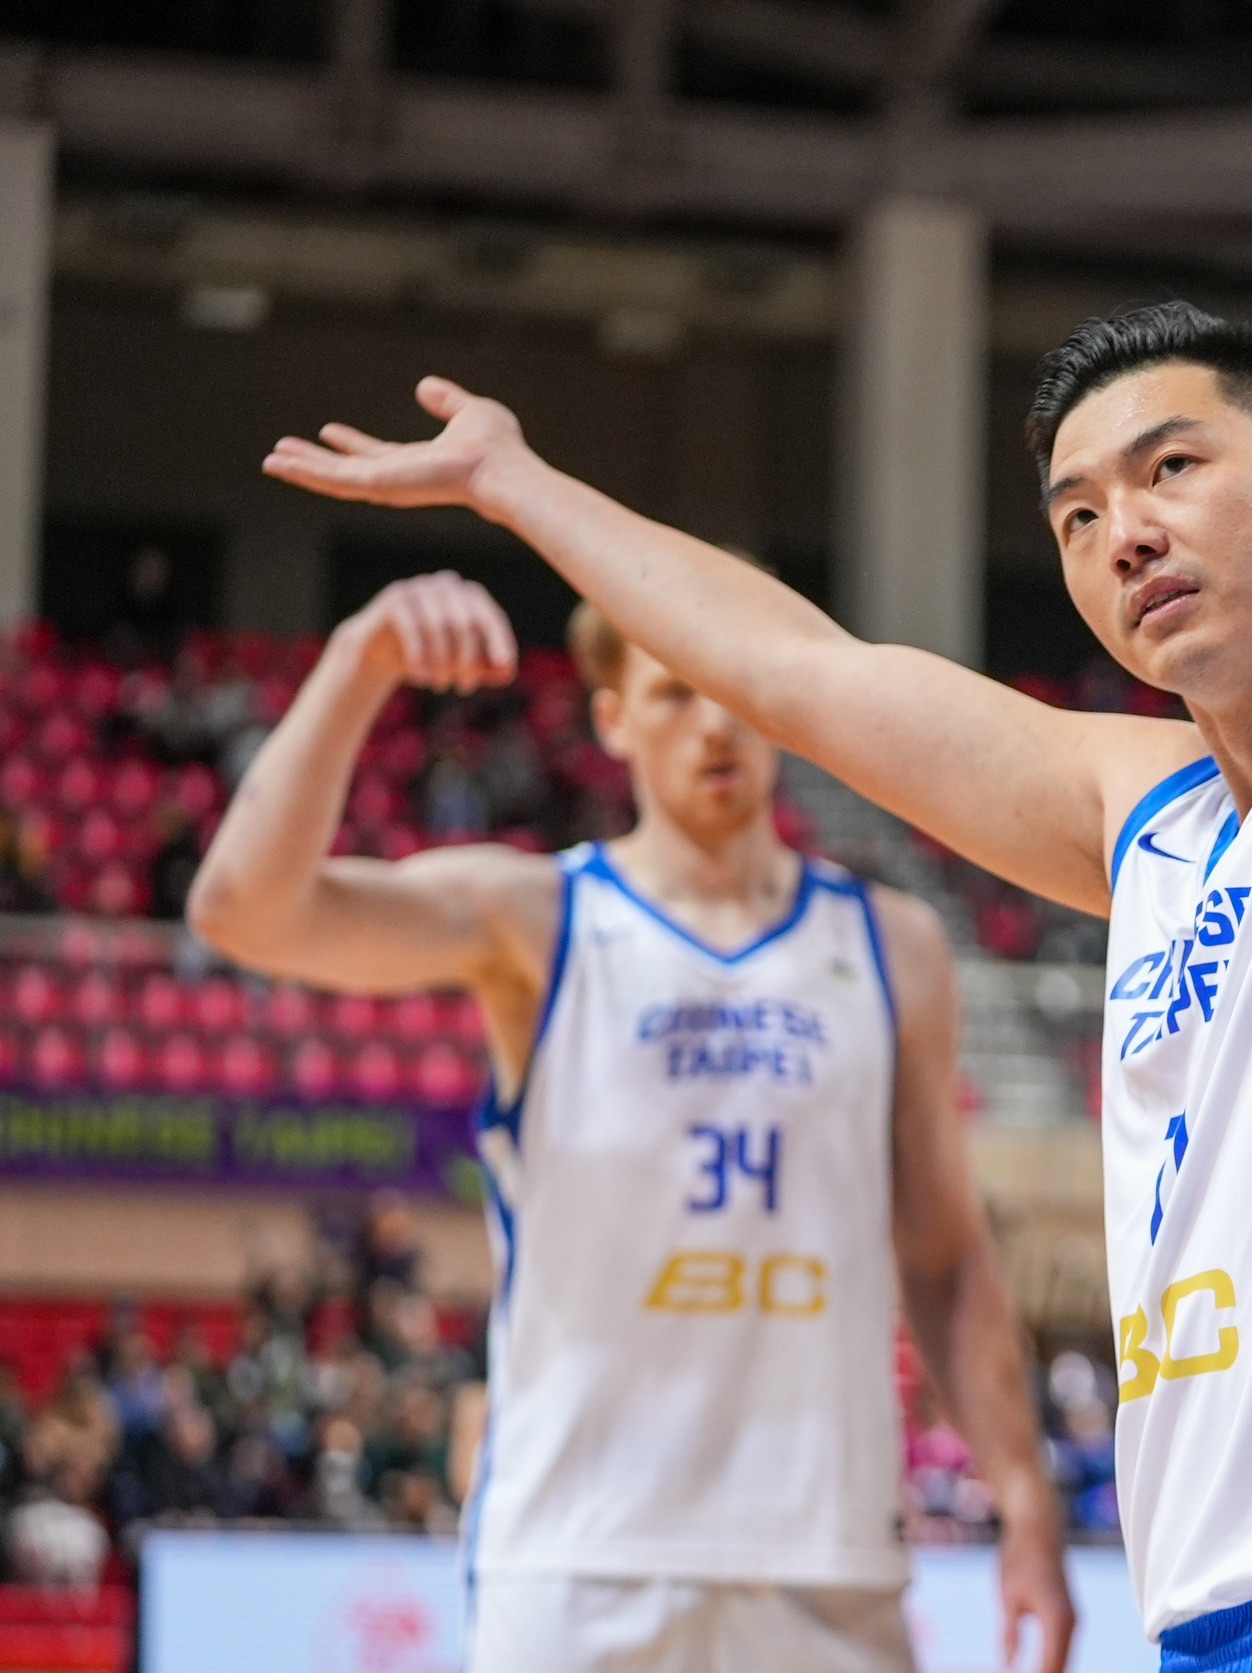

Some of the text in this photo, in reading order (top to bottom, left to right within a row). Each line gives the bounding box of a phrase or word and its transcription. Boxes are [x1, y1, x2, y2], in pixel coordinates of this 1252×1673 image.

[686, 1122, 783, 1217] 34
[644, 1249, 829, 1320] BC
[1118, 1268, 1240, 1405] BC
